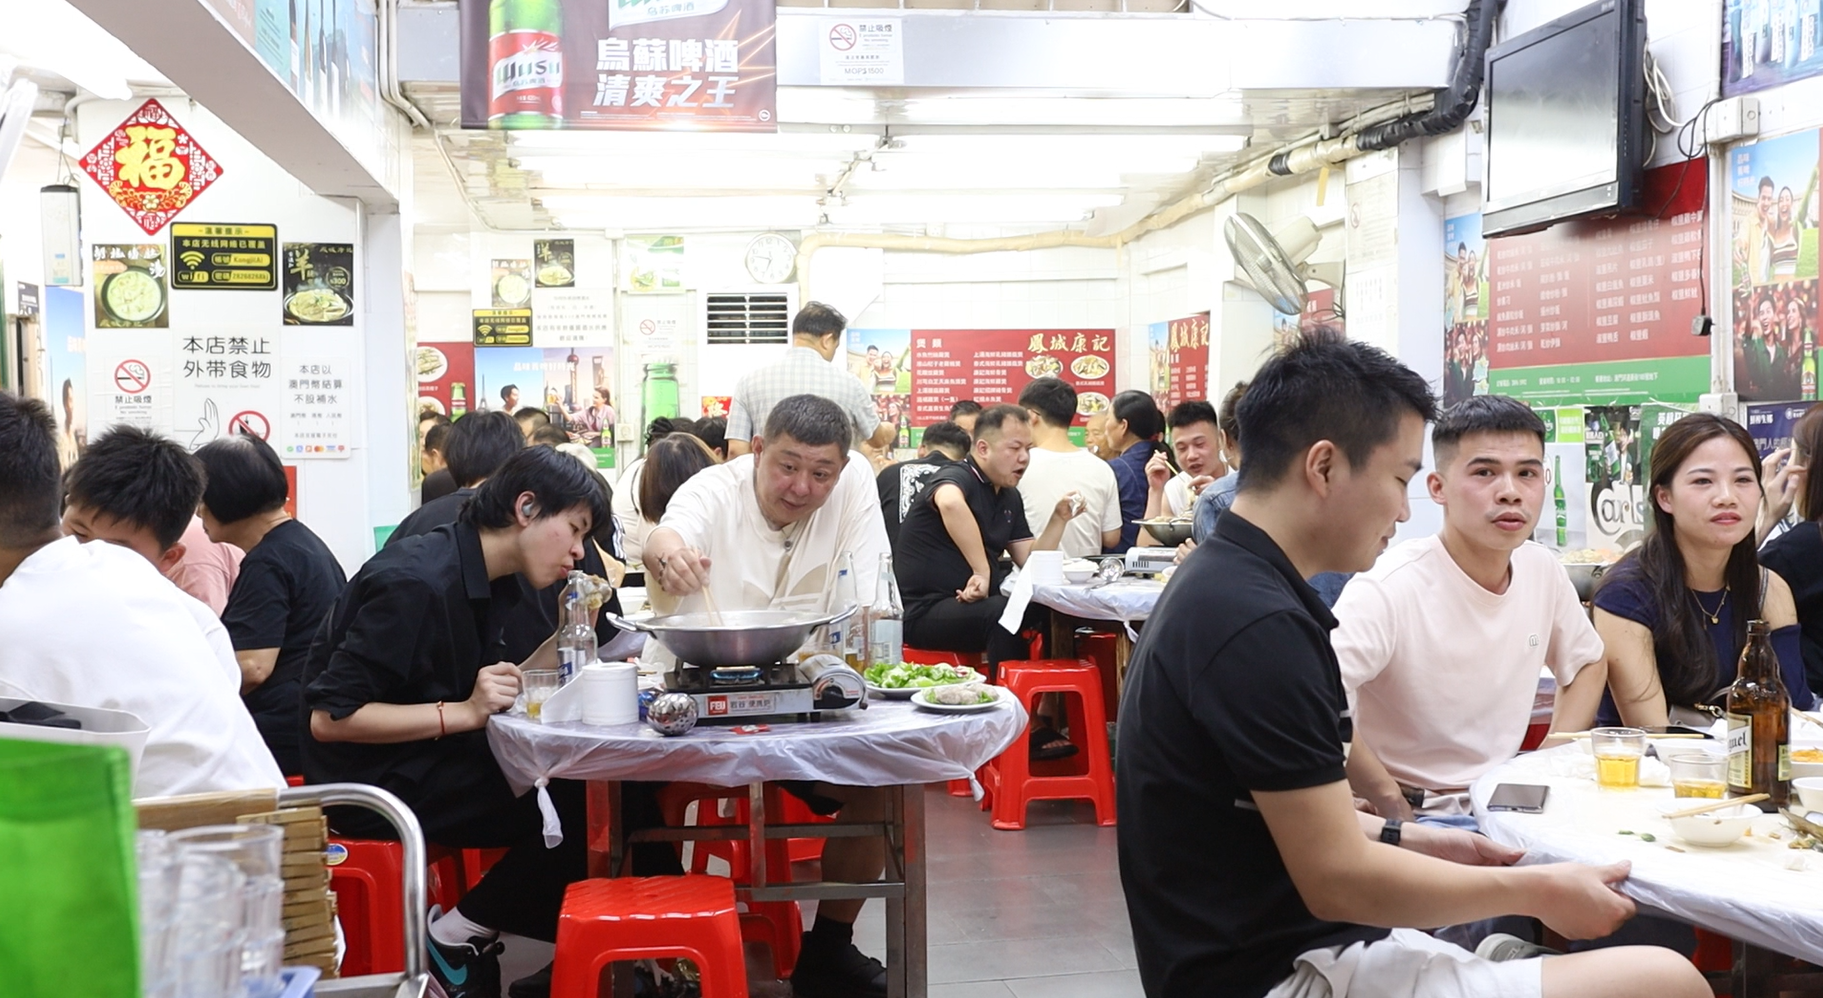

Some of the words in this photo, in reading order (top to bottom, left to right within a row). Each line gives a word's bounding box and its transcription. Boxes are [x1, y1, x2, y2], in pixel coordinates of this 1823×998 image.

[596, 38, 738, 72] 烏蘇啤酒
[593, 75, 739, 108] 清爽之王
[114, 126, 186, 188] 福
[290, 248, 314, 280] 羊
[183, 336, 271, 354] 本店禁止
[1028, 332, 1110, 353] 鳳城康記
[183, 360, 271, 379] 外带食物
[299, 364, 332, 375] 本店以
[294, 394, 337, 404] 不設補水
